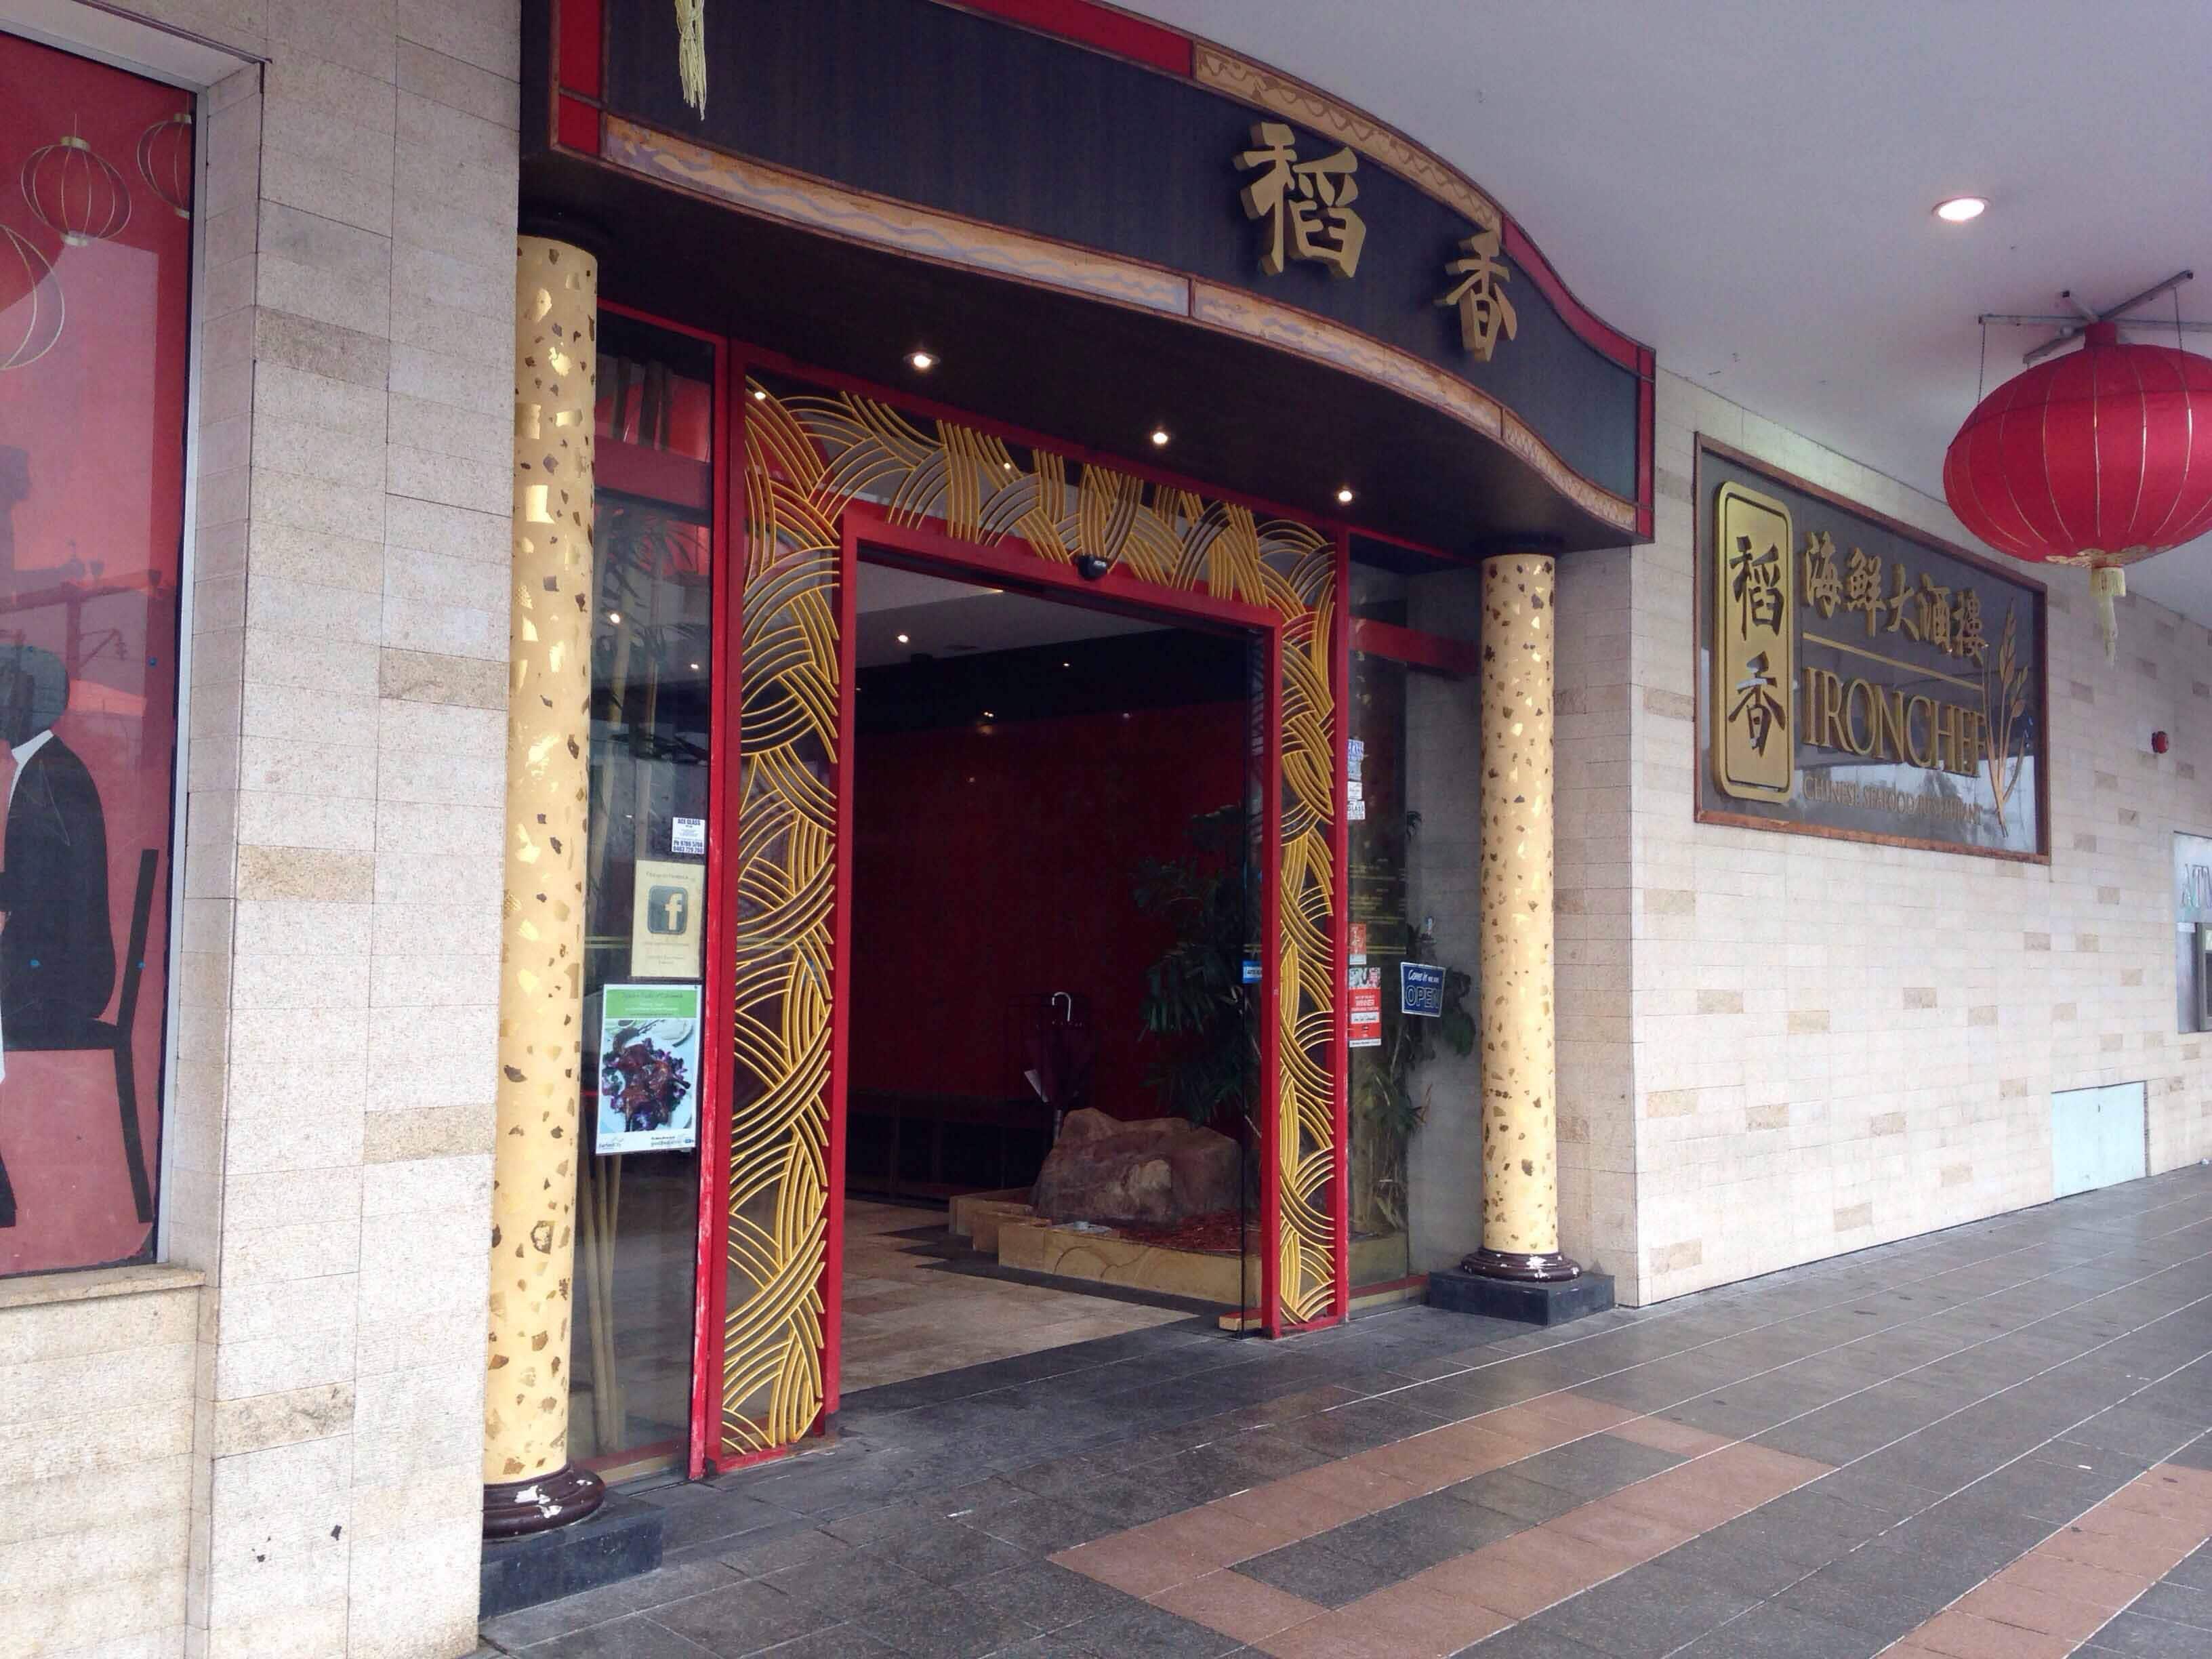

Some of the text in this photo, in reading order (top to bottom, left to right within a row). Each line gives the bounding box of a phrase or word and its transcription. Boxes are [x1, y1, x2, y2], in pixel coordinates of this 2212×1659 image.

[1232, 121, 1517, 363] 稻香
[1729, 535, 1786, 758] 稻香
[1803, 776, 1859, 806] CHINESE
[1863, 784, 1915, 815] SEAFOOD
[1405, 985, 1439, 1009] OPEN
